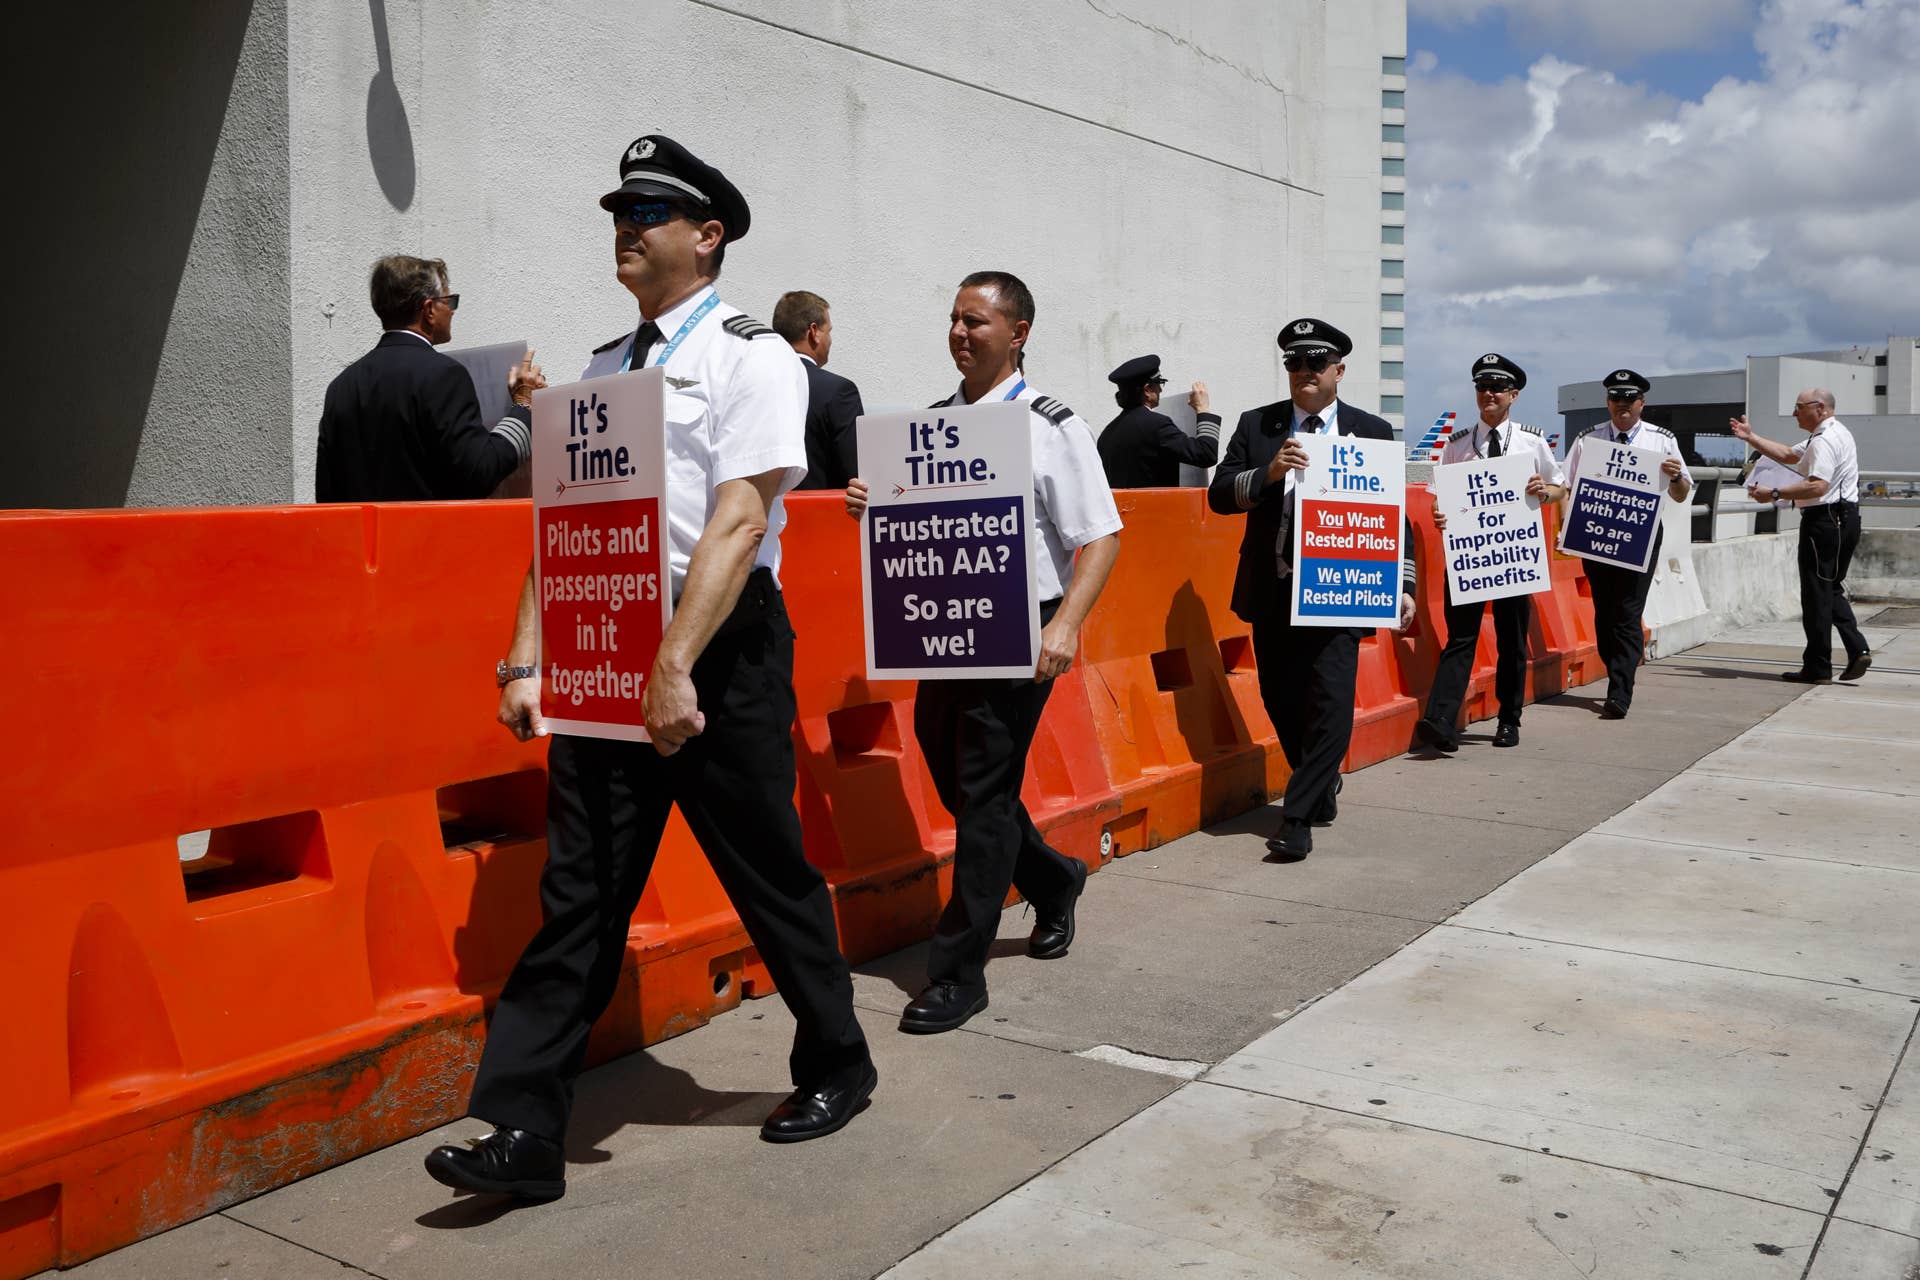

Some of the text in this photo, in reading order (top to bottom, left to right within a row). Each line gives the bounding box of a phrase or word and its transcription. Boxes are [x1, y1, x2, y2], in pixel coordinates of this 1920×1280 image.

[569, 393, 608, 437] It's
[910, 418, 960, 451] It's
[566, 440, 637, 482] Time.
[1332, 444, 1364, 467] It's
[1609, 448, 1637, 466] It's
[905, 453, 996, 485] Time.
[1328, 468, 1385, 492] Time.
[1468, 471, 1498, 490] It's
[1605, 462, 1651, 485] Time.
[1467, 489, 1520, 508] Time.
[1579, 482, 1657, 512] Frustrated
[874, 506, 1018, 543] Frustrated
[1317, 510, 1385, 529] You Want
[1478, 511, 1506, 529] for
[1580, 501, 1648, 526] with AA?
[547, 515, 649, 557] Pilots and
[1305, 531, 1396, 550] Rested Pilots
[1449, 521, 1539, 551] improved
[1585, 520, 1632, 542] So are
[1453, 547, 1541, 572] disability
[1591, 540, 1619, 556] we!
[883, 545, 1010, 578] with AA?
[1317, 567, 1383, 585] We Want
[1458, 567, 1541, 592] benefits.
[544, 572, 657, 612] passengers
[1303, 588, 1393, 607] Rested Pilots
[903, 594, 993, 621] So are
[576, 614, 618, 652] in it
[922, 628, 976, 656] we!
